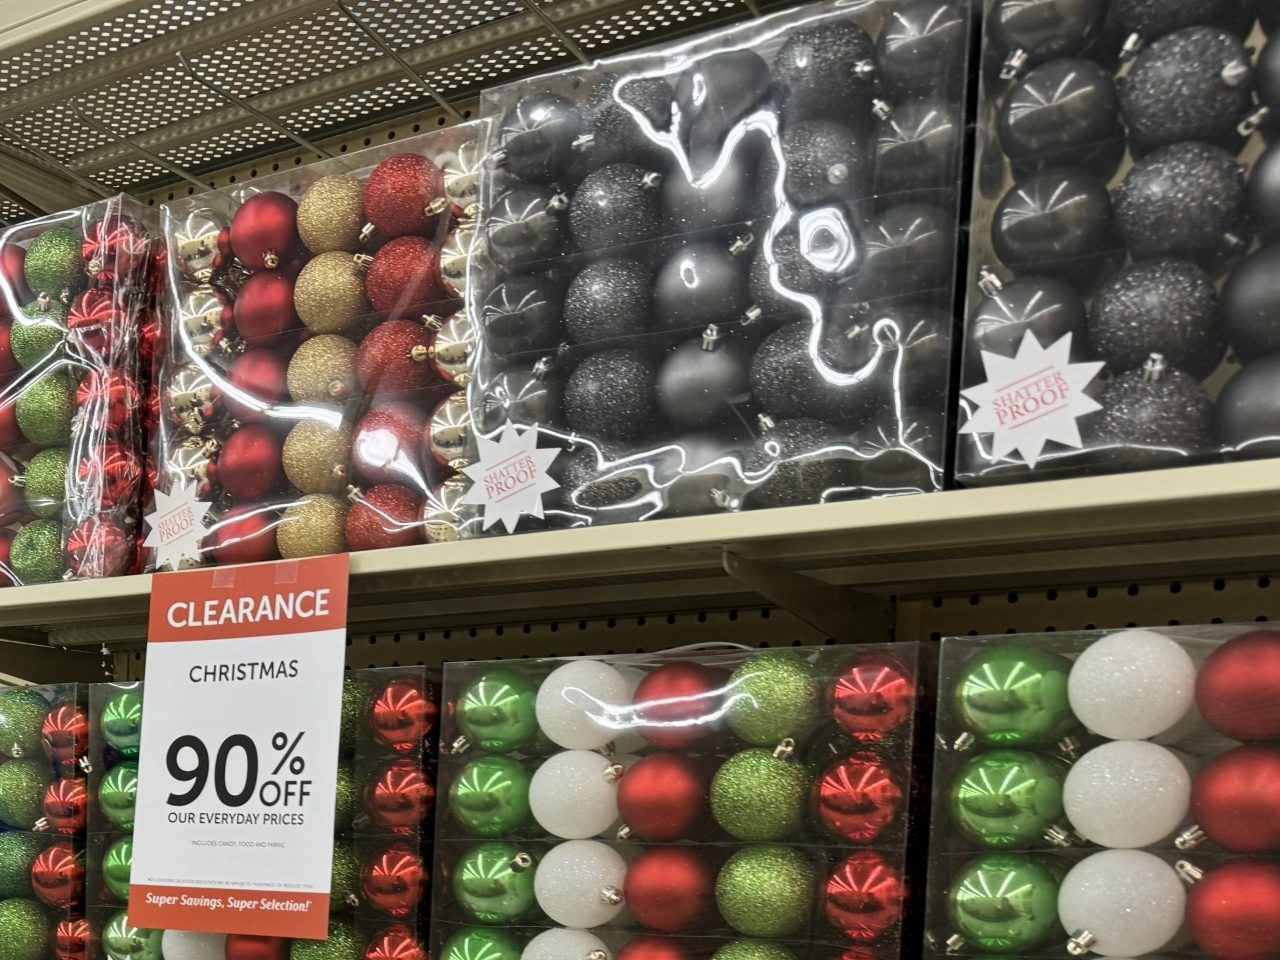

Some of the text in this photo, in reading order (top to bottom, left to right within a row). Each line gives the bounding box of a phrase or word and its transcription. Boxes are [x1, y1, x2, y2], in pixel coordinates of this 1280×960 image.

[992, 371, 1064, 408] SHATTER
[995, 382, 1069, 425] PROOF
[483, 455, 535, 485] SHATTER
[485, 464, 537, 499] PROOF
[160, 515, 195, 542] PROOF
[167, 588, 331, 628] CLEARANCE
[189, 660, 299, 683] CHRISTMAS
[259, 780, 312, 807] OFF
[168, 811, 304, 826] OUR EVERYDAY PRICES
[145, 893, 310, 912] Super Savings, Super Selection!
